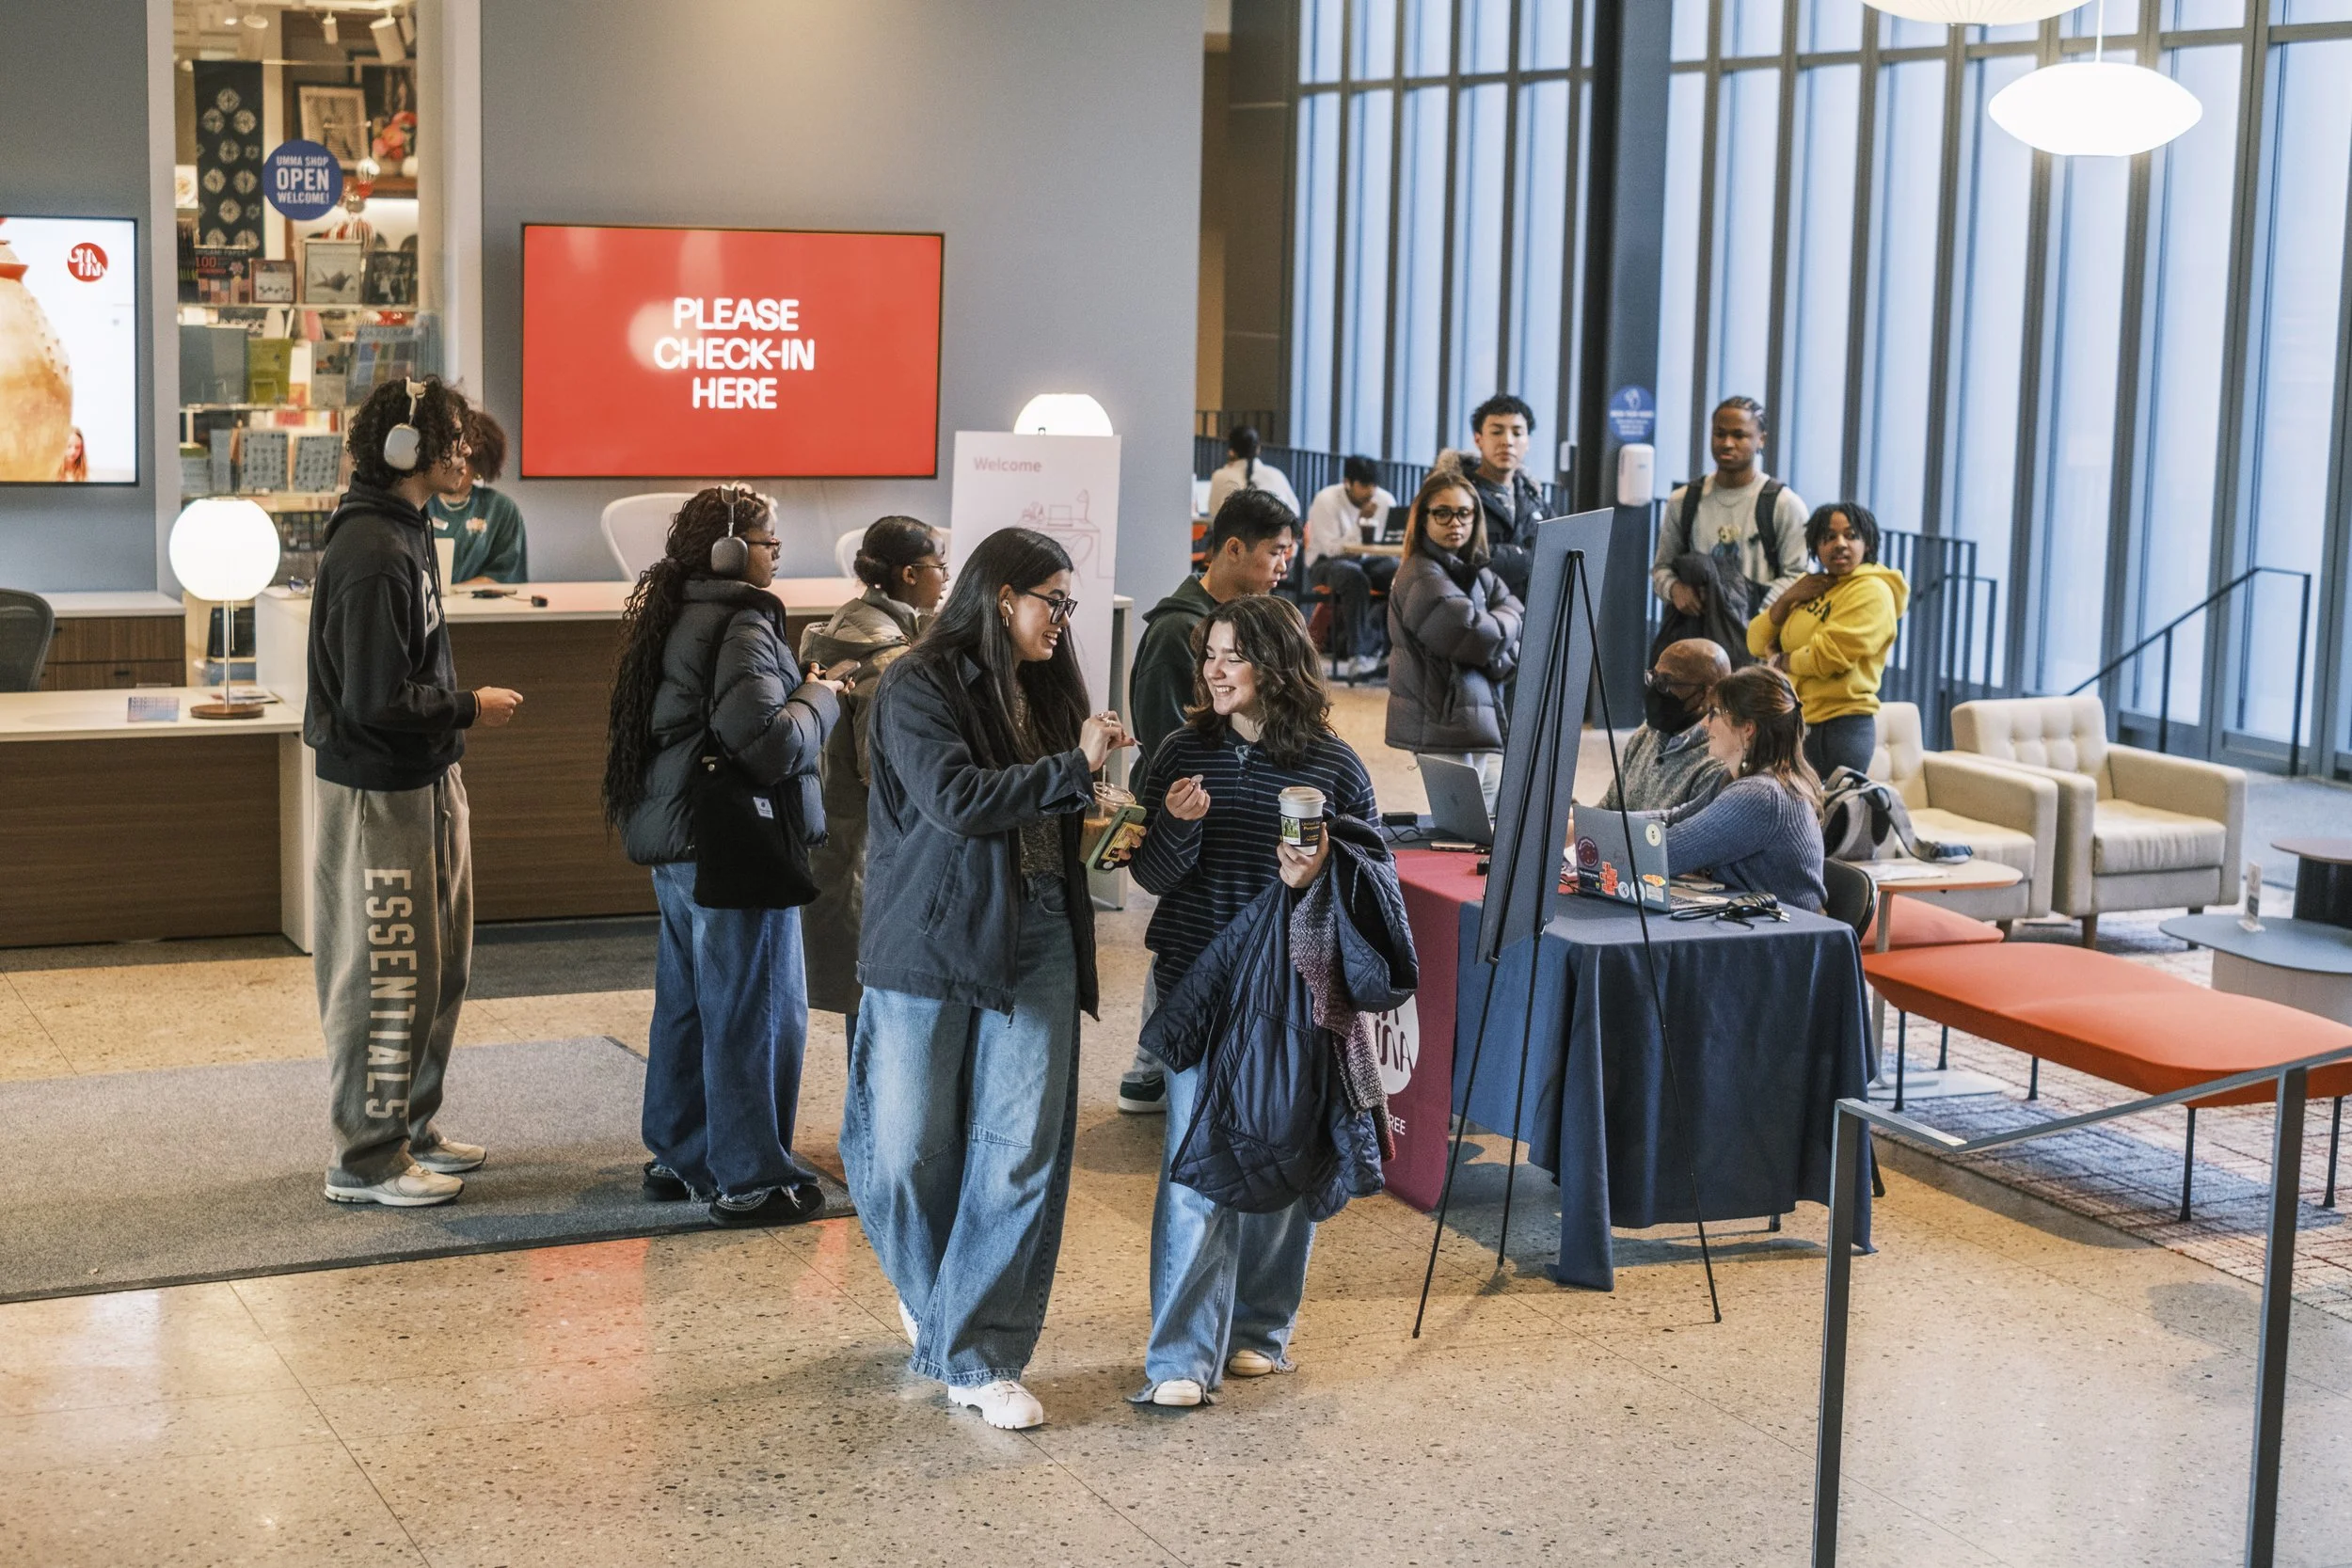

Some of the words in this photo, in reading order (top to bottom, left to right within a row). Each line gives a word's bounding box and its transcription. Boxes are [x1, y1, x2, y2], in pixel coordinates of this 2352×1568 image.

[277, 155, 304, 166] UMMA
[305, 155, 329, 167] SHOP
[276, 167, 330, 192] OPEN
[277, 191, 330, 205] WELCOME!
[673, 296, 800, 331] PLEASE
[653, 336, 816, 372] CHECK-IN
[691, 376, 778, 410] HERE
[973, 456, 1042, 473] Welcome
[364, 868, 418, 1119] ESSENTIALS
[1389, 1113, 1406, 1136] REE
